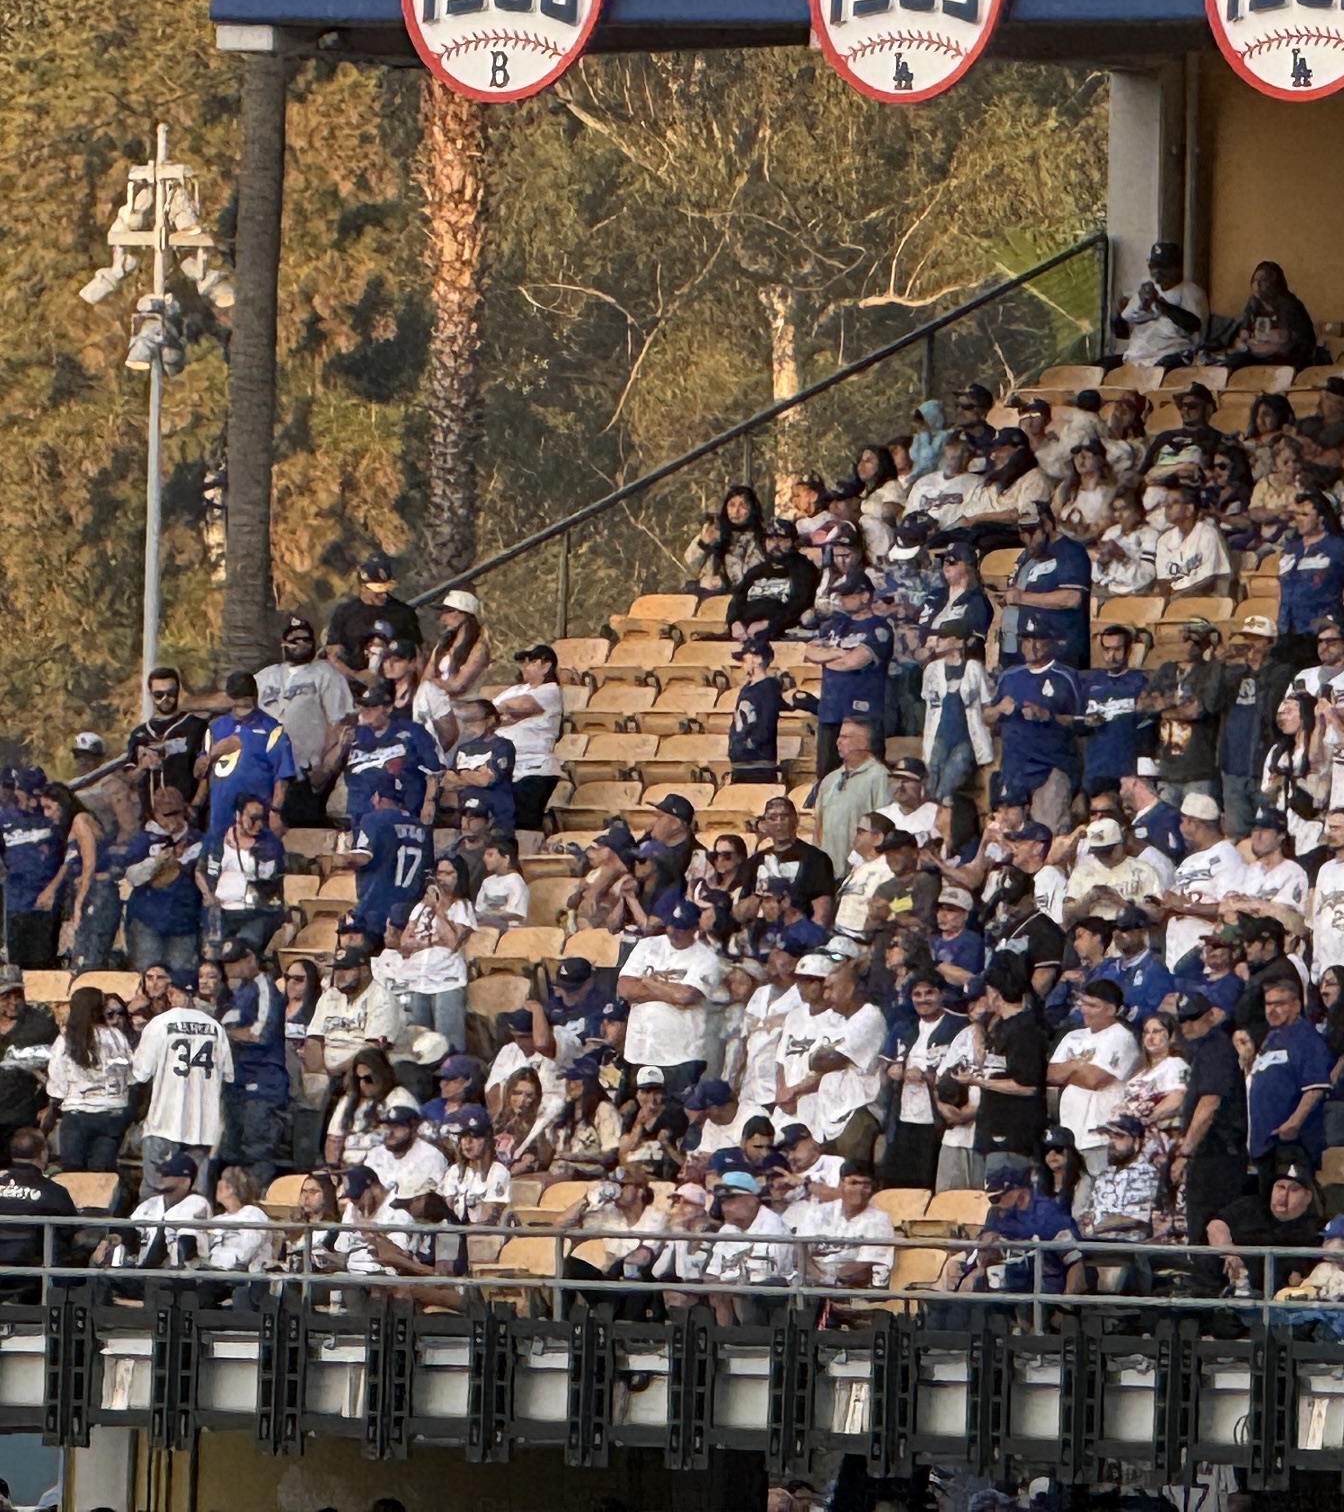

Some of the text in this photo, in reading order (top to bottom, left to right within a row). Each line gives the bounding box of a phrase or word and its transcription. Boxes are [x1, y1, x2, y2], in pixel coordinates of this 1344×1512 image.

[490, 50, 510, 89] B
[394, 844, 423, 889] 17
[170, 1039, 215, 1080] 34
